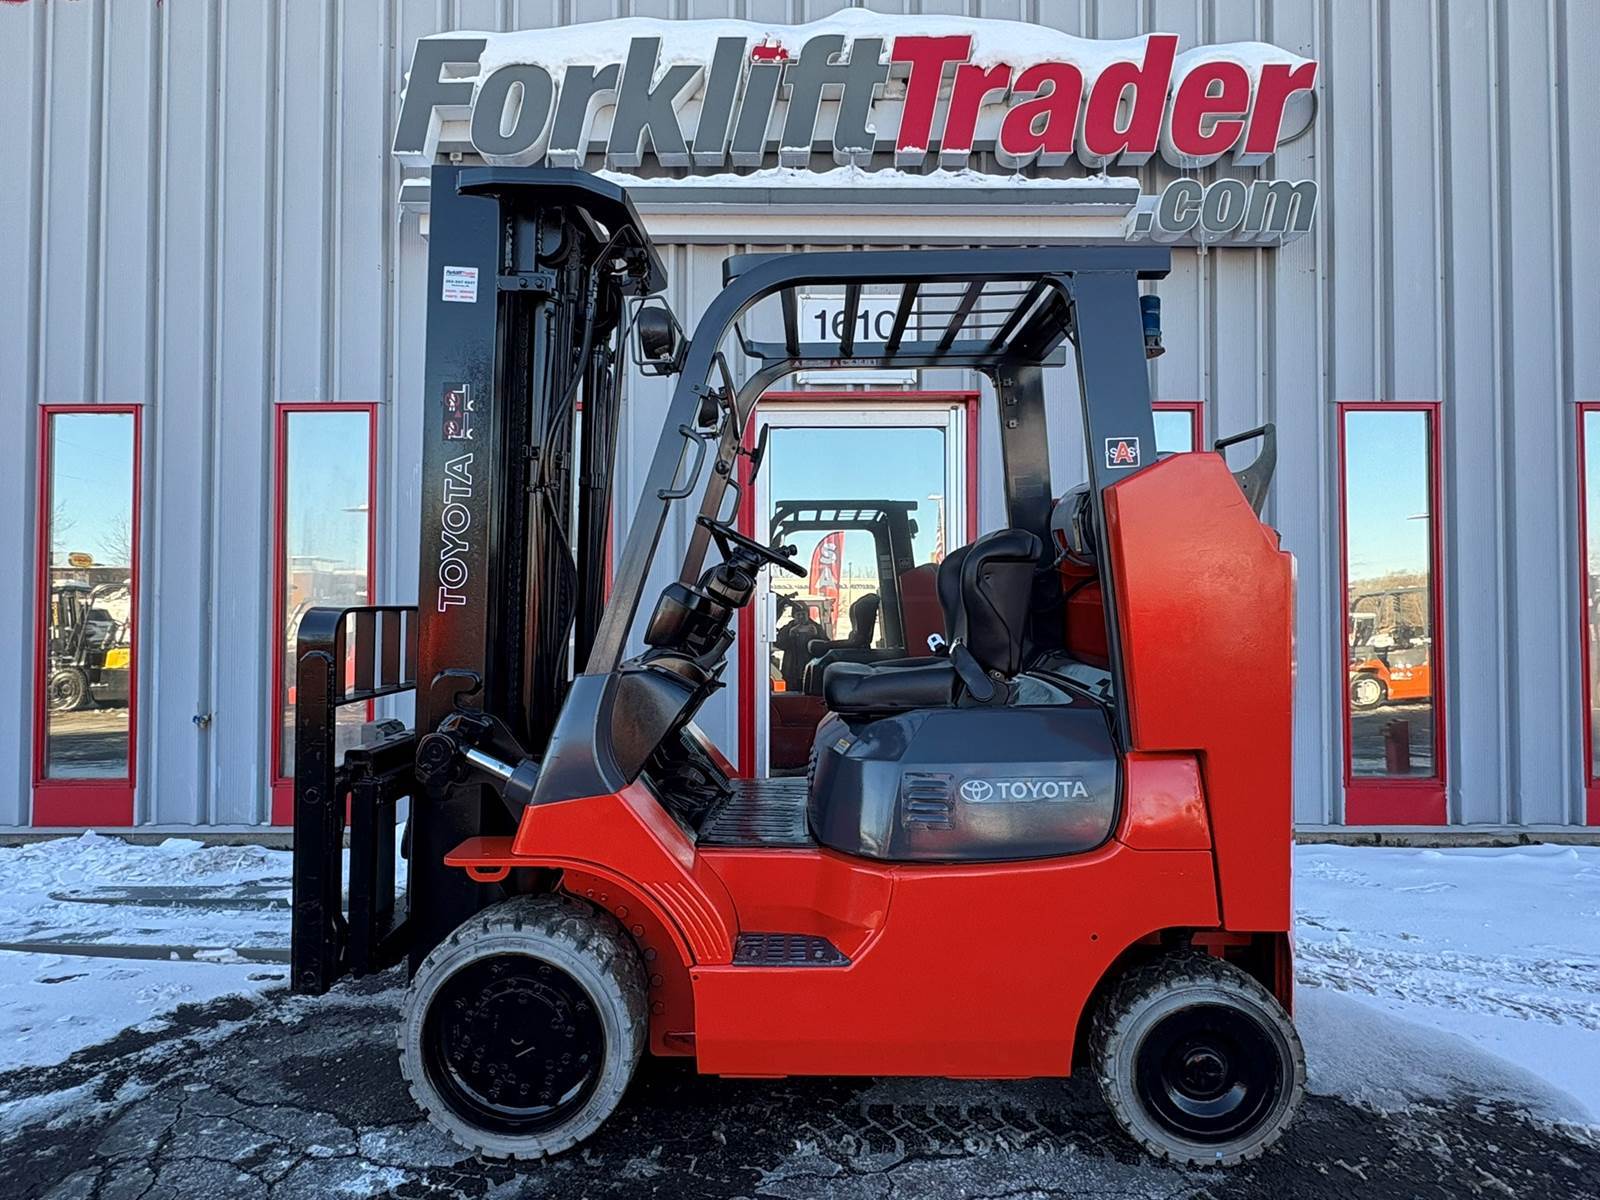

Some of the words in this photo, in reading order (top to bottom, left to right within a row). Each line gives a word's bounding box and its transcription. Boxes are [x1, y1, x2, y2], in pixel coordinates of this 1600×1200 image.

[391, 36, 1318, 155] ForkliftTrader
[1134, 179, 1318, 232] .com
[1110, 441, 1136, 463] SAS
[438, 453, 473, 612] TOYOTA
[997, 781, 1088, 798] TOYOTA
